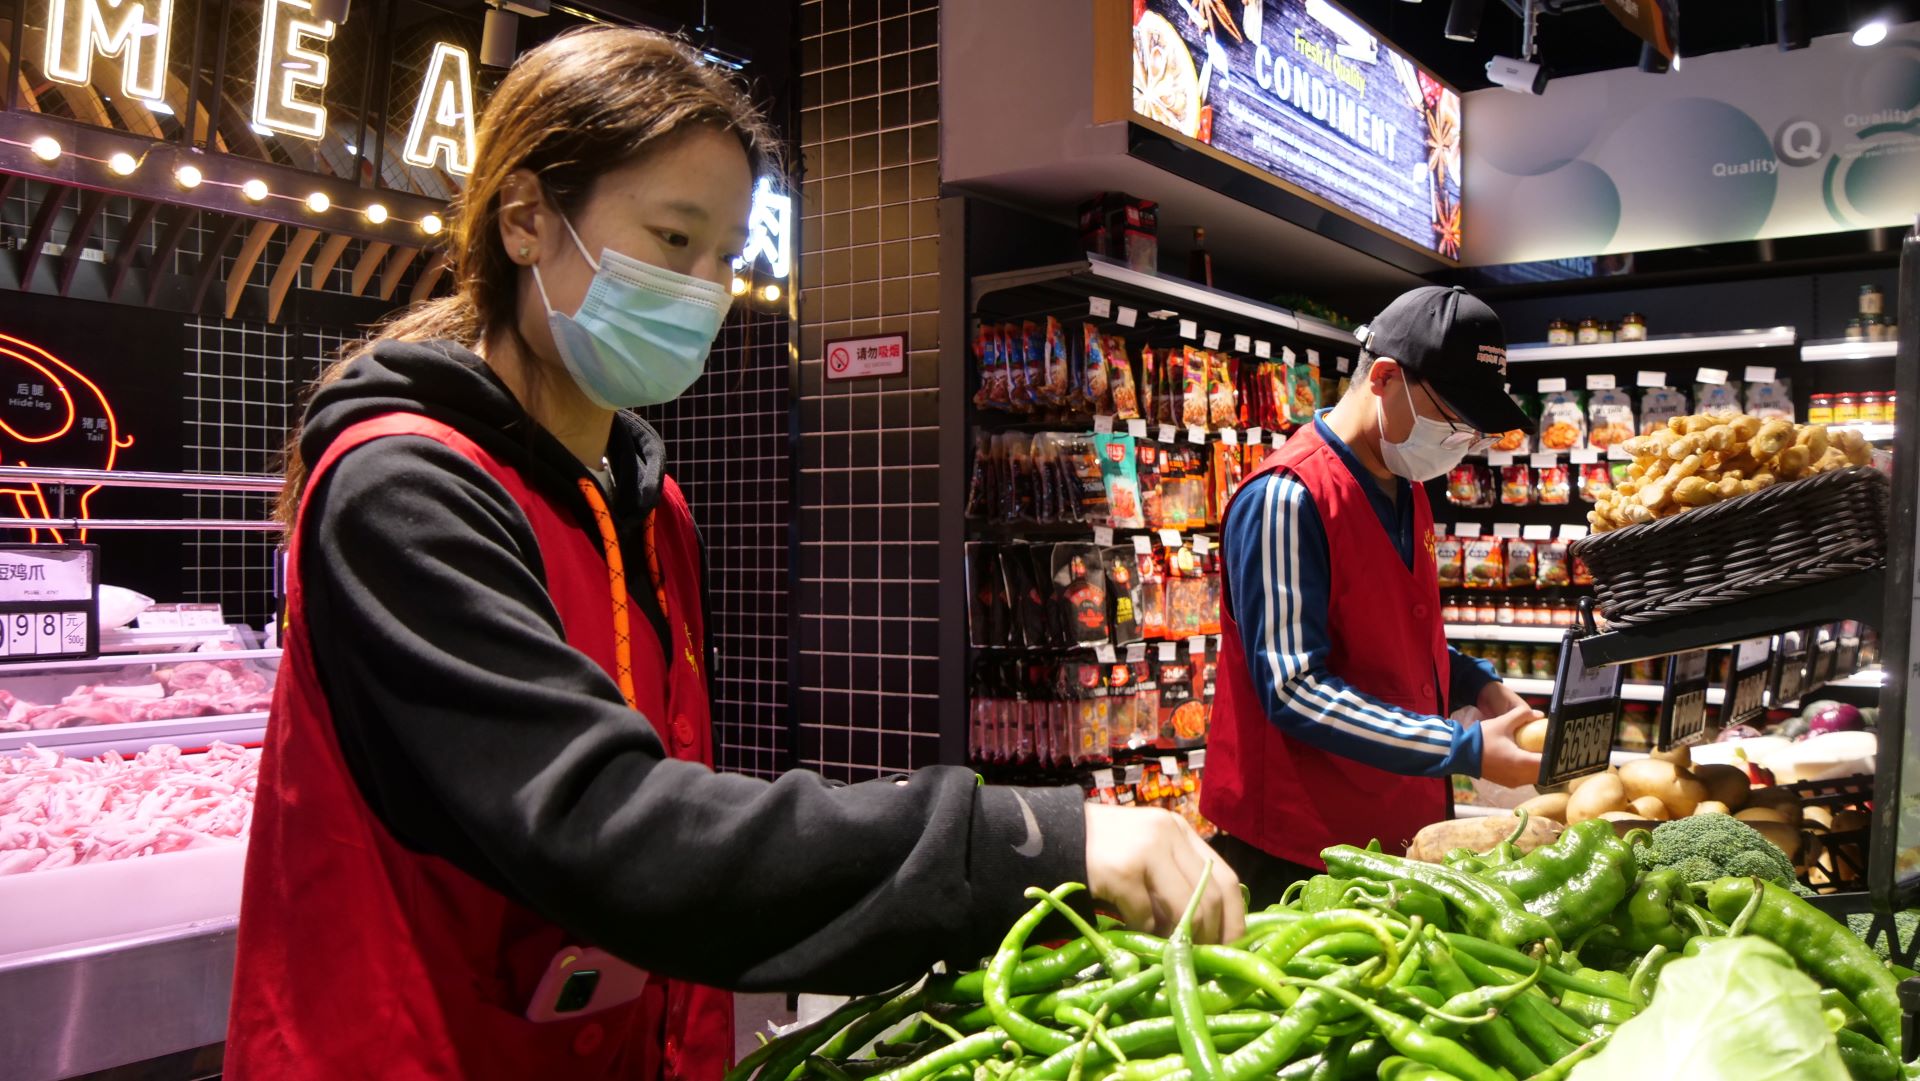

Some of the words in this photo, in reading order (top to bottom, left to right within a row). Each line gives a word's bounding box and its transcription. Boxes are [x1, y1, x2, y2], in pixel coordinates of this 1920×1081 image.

[1295, 27, 1323, 67] Fresh
[1324, 48, 1333, 73] &
[1333, 53, 1366, 99] Quality
[1254, 44, 1396, 162] CONDIMENT
[1843, 108, 1912, 130] Quality
[1781, 120, 1823, 161] Q
[1712, 159, 1779, 178] Quality
[856, 343, 900, 361] 请勿吸烟
[17, 383, 44, 397] 后腿
[35, 399, 52, 411] leg
[82, 417, 108, 430] 猪尾
[87, 432, 104, 442] Tail
